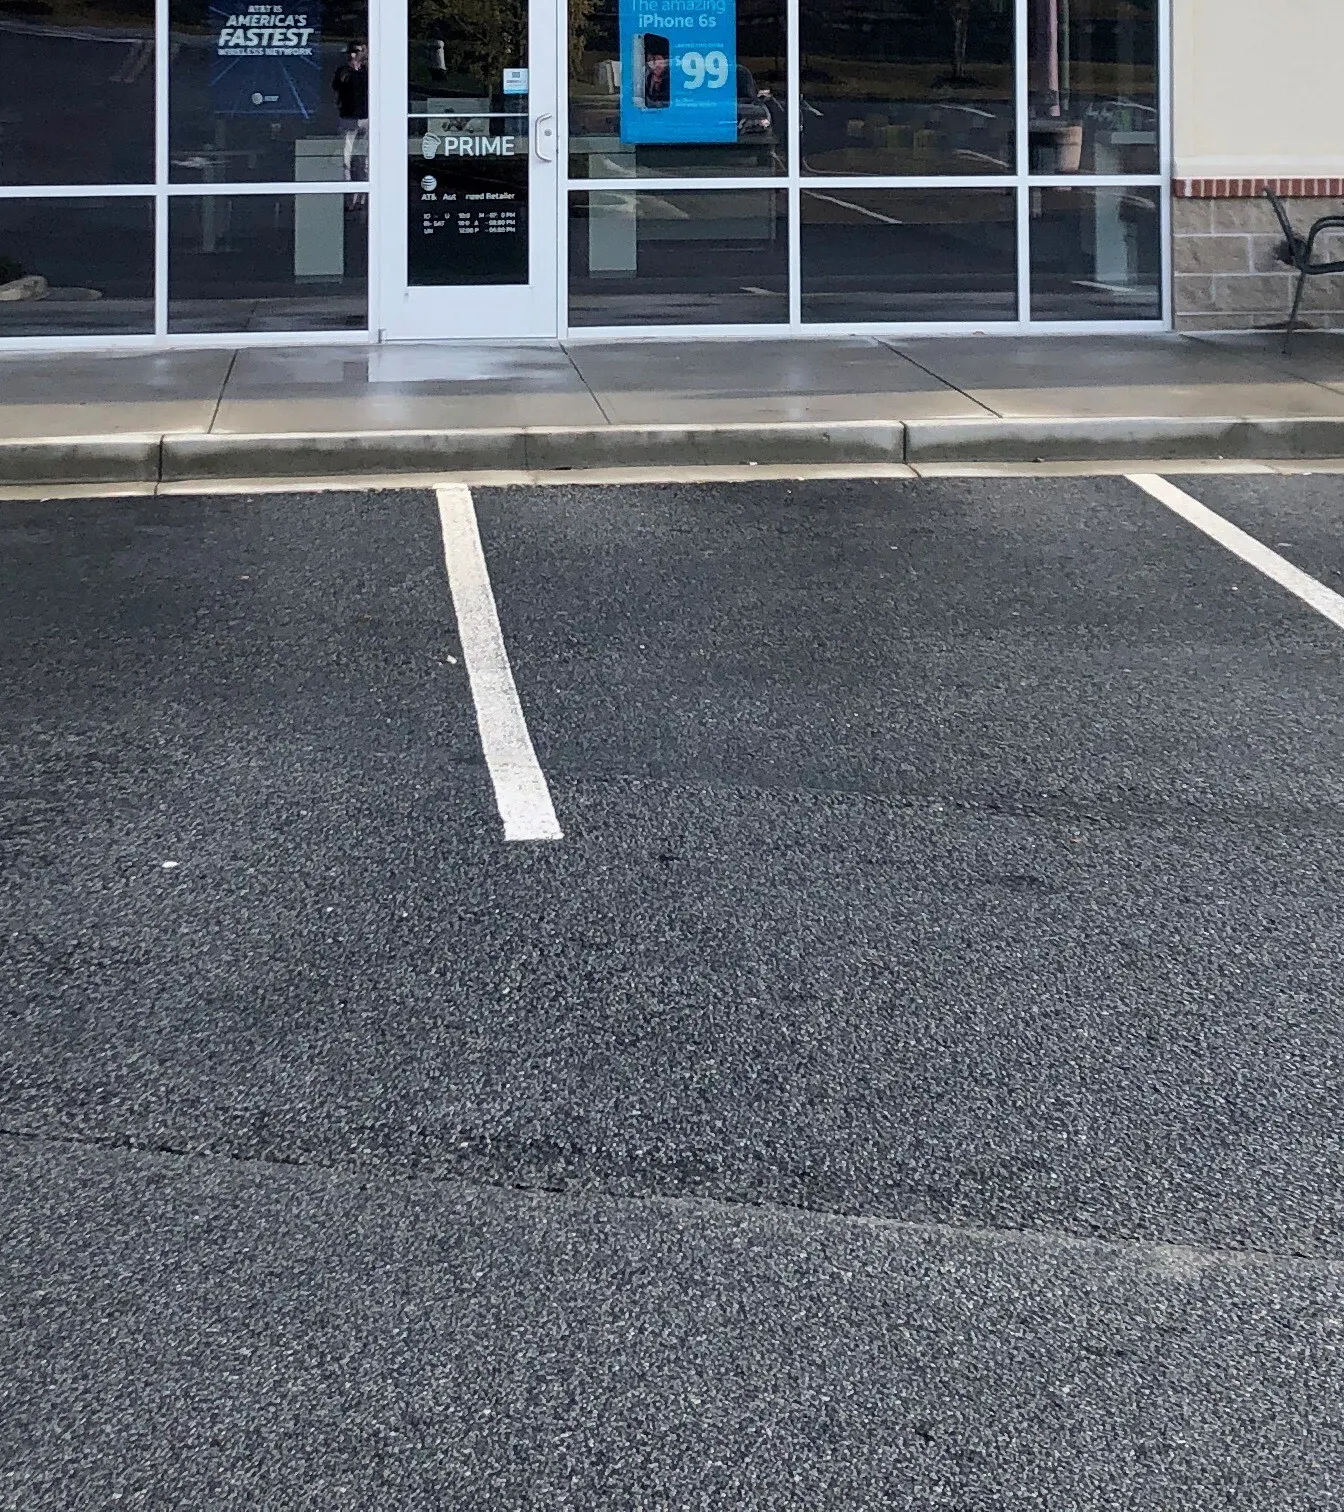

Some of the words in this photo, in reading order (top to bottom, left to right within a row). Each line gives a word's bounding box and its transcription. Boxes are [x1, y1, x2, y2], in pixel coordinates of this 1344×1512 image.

[226, 15, 307, 26] AMERICA'S
[638, 14, 694, 28] iPhone
[698, 14, 716, 28] 6s
[218, 28, 314, 46] FASTEST
[444, 136, 515, 156] PRIME
